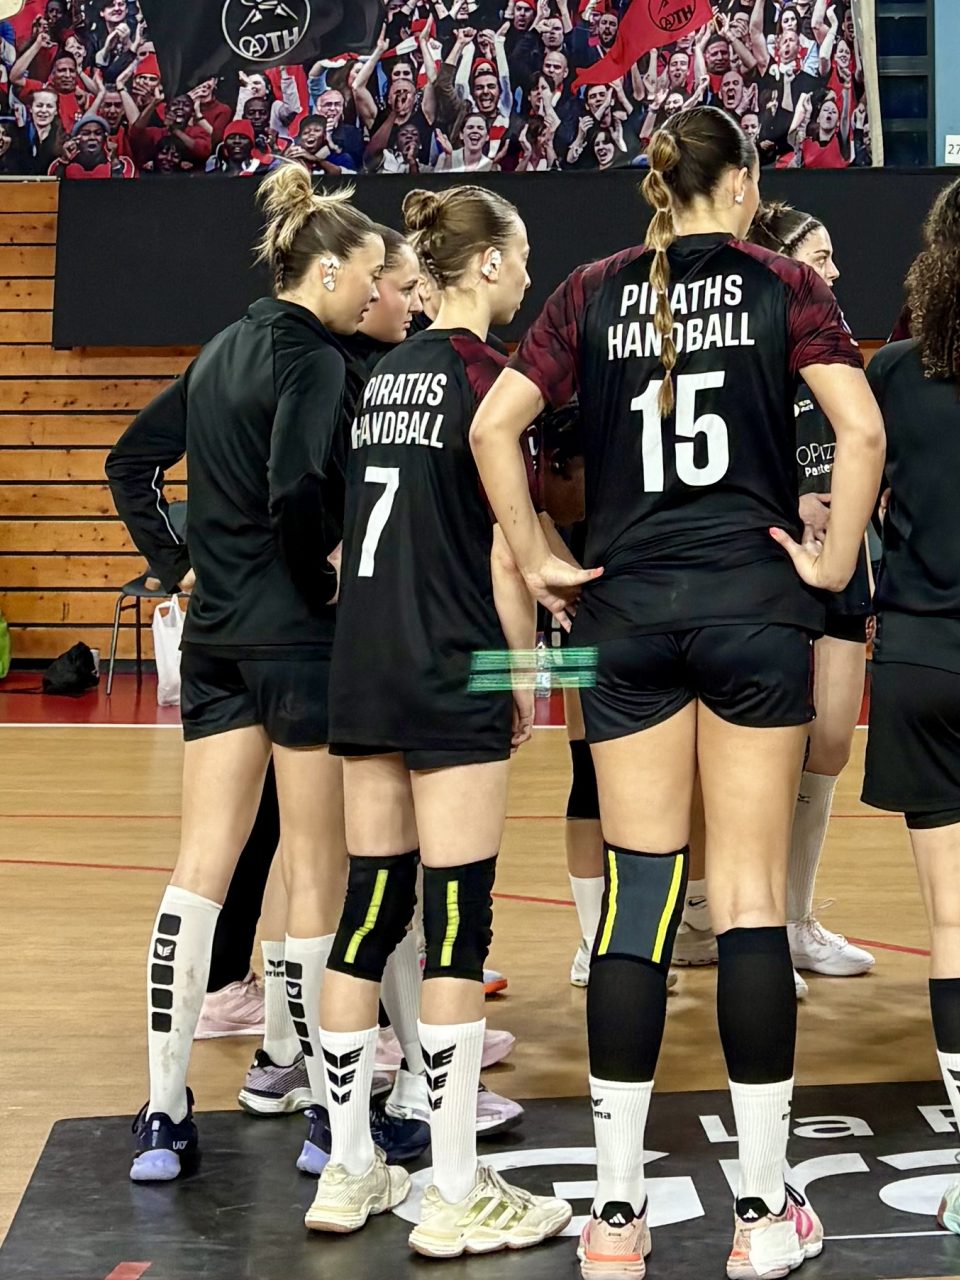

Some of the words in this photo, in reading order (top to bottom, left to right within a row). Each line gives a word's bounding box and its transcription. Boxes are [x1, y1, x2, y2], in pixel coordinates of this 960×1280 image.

[363, 372, 448, 409] PIRATHS
[630, 370, 730, 493] 15
[357, 466, 400, 577] 7
